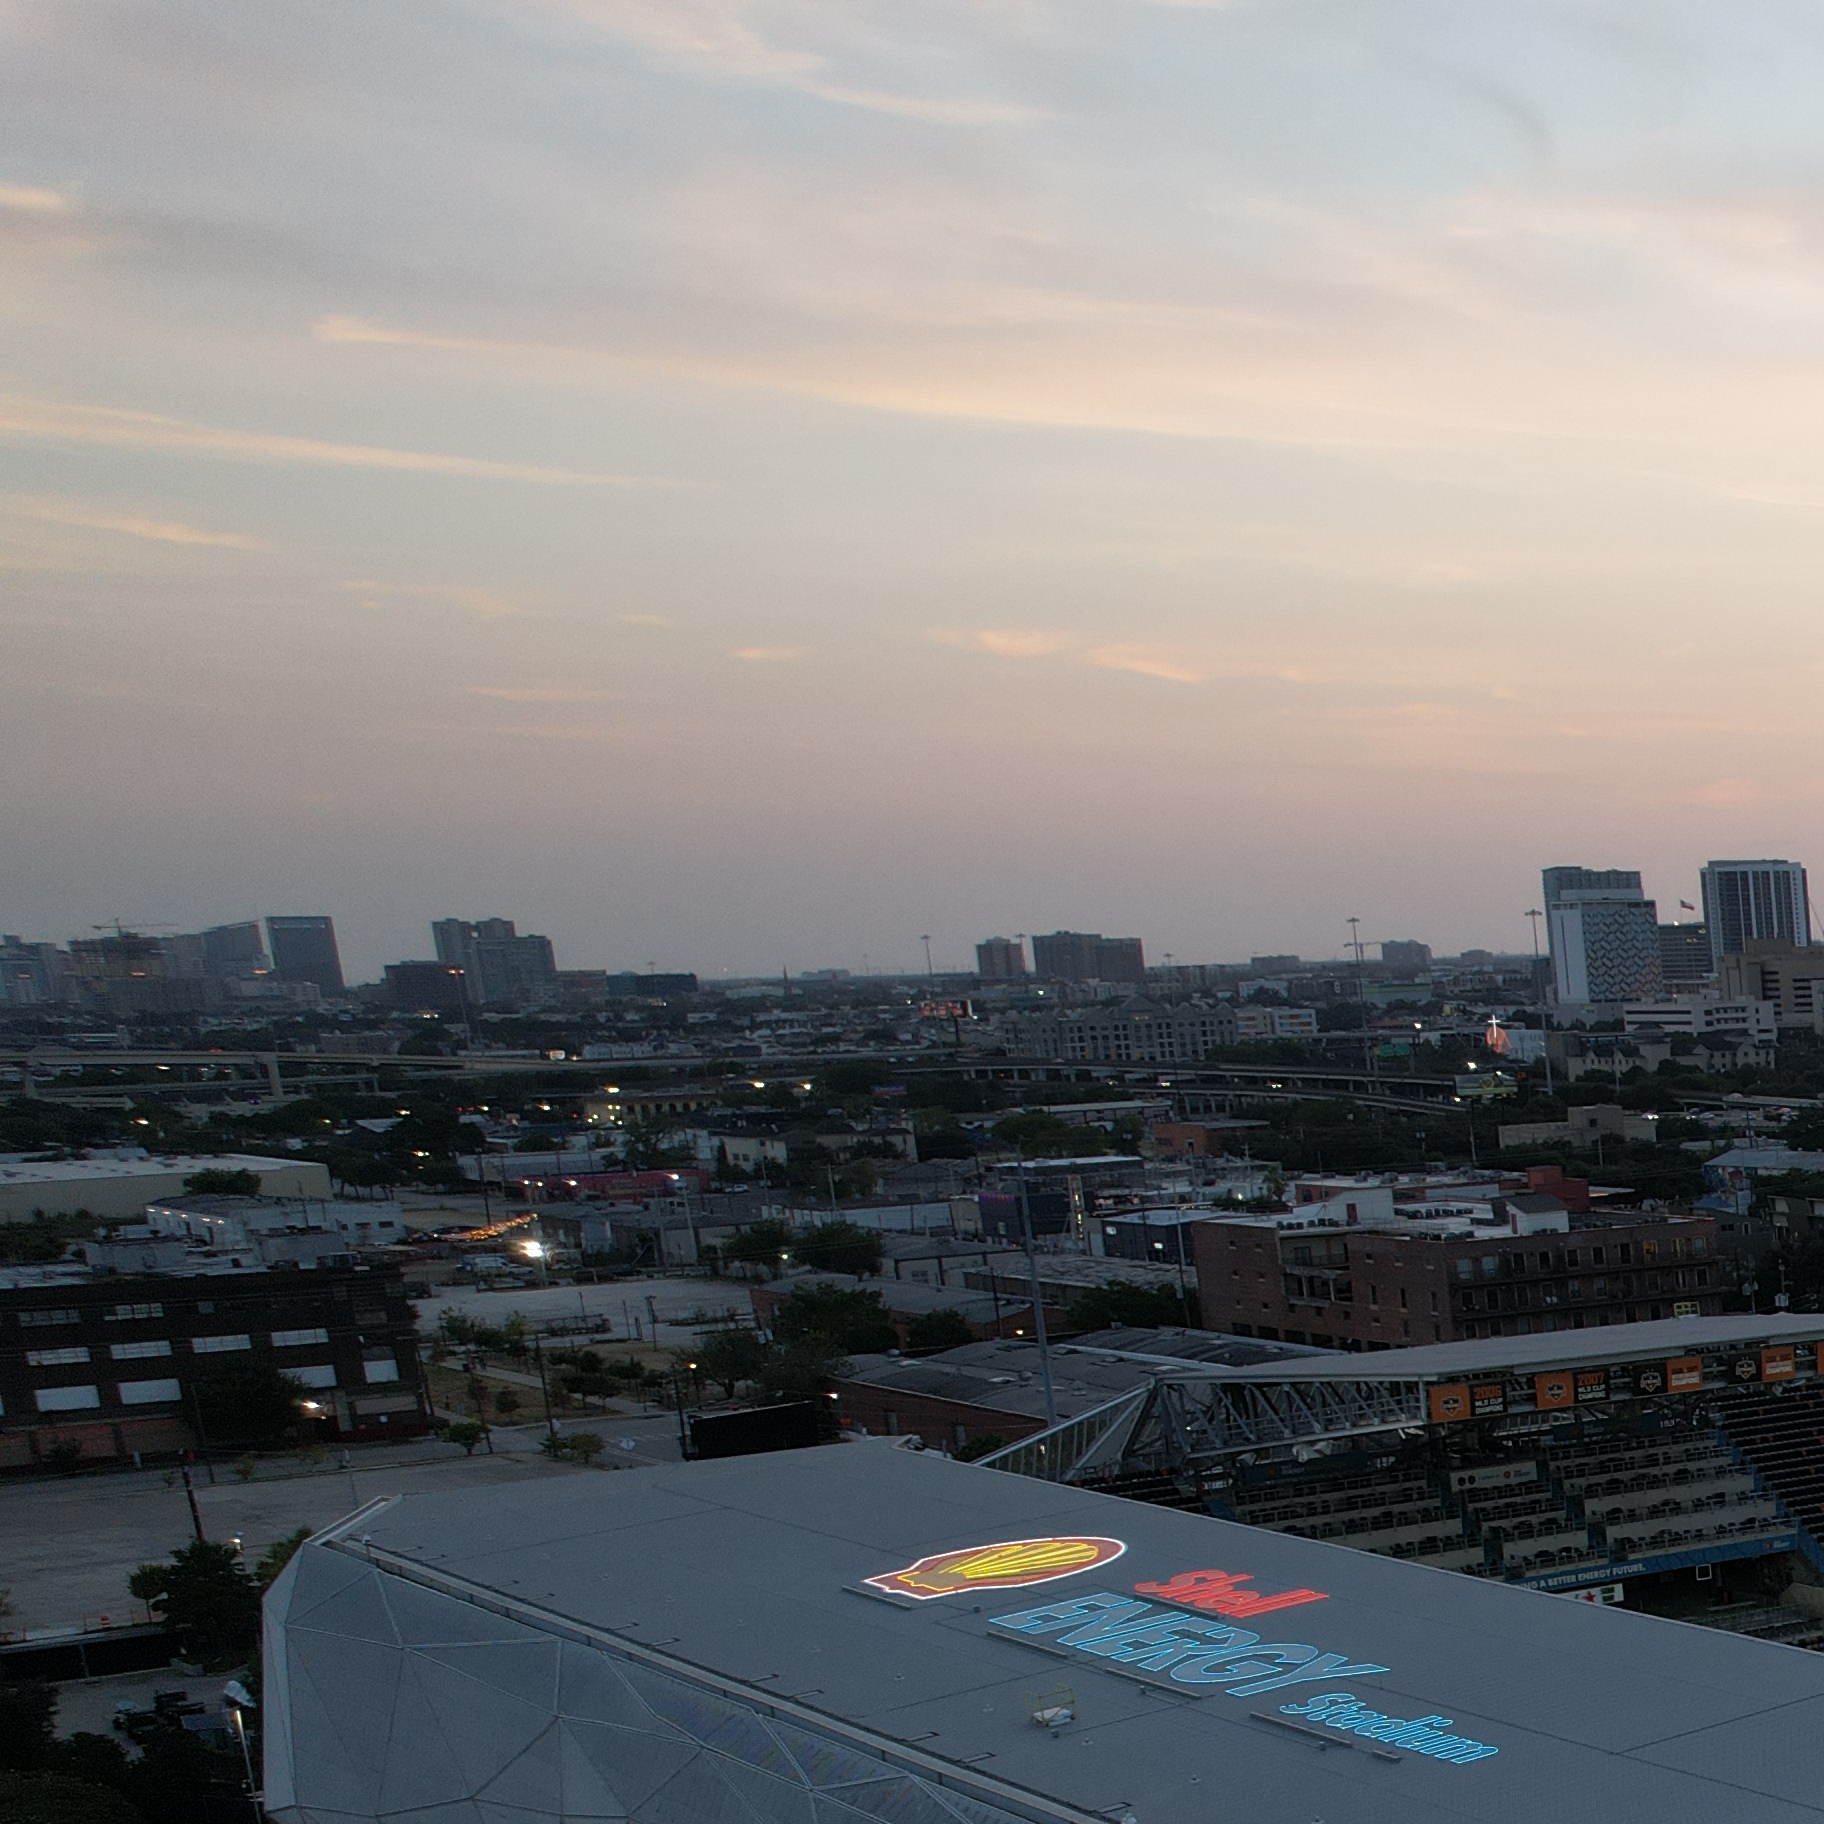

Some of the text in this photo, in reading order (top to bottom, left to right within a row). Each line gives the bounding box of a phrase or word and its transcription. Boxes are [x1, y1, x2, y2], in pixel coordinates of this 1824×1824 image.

[1133, 1569, 1330, 1618] Shell
[1577, 1567, 1612, 1584] ENERGY
[989, 1592, 1391, 1697] ENERGY
[1279, 1693, 1498, 1764] Stadium
